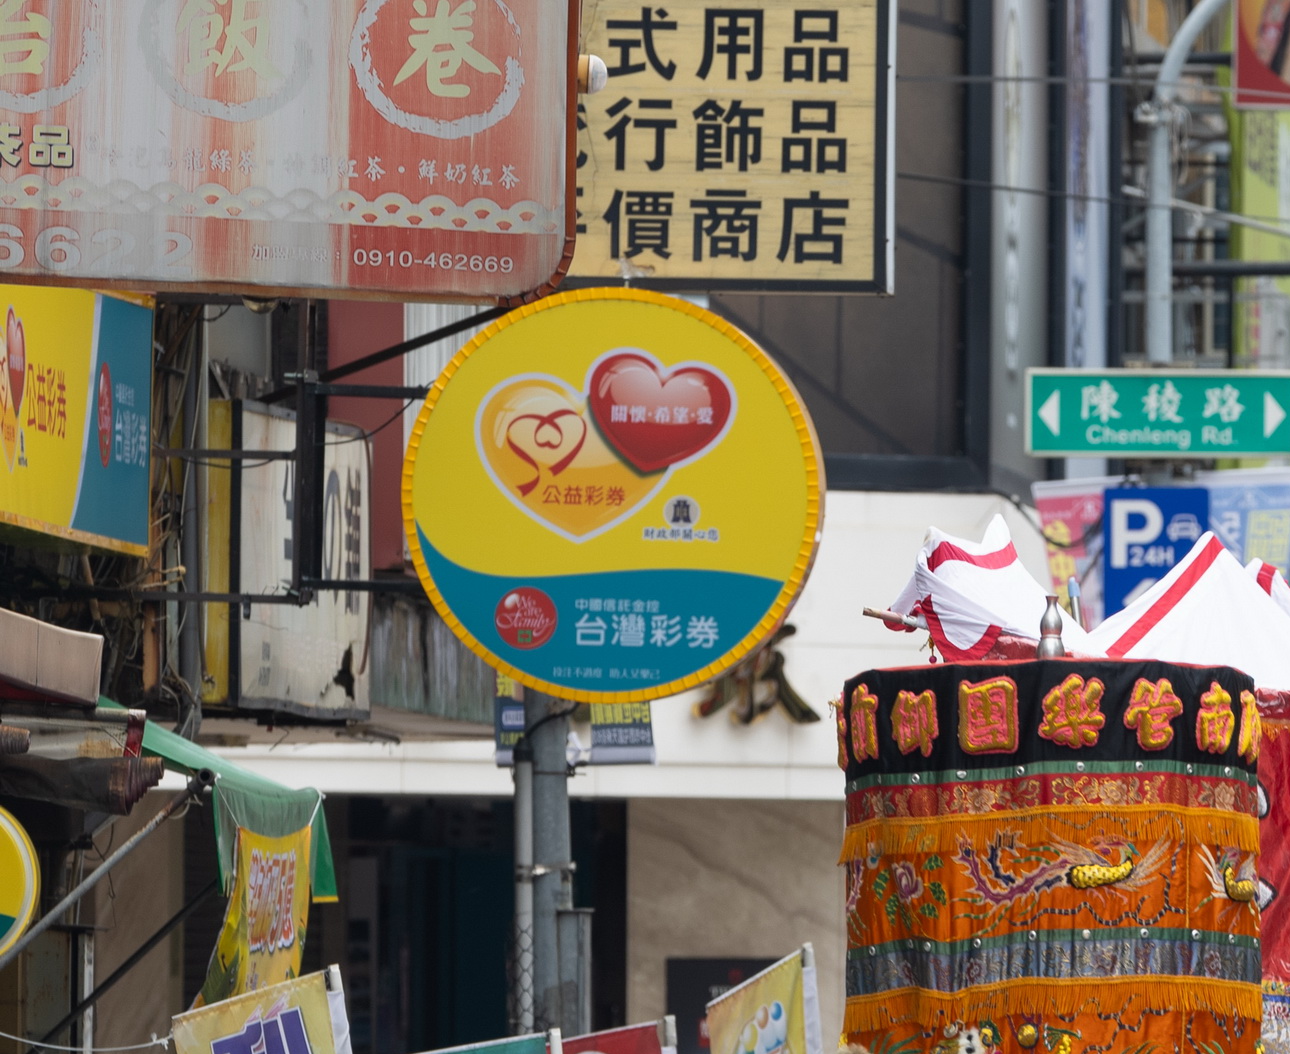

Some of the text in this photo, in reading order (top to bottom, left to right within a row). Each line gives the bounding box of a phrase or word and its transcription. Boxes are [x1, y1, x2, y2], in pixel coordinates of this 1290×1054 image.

[606, 6, 849, 83] 式用品
[576, 97, 847, 173] 行飾品
[576, 189, 849, 264] 價商店
[353, 247, 514, 274] 0910-462669
[26, 362, 67, 440] 公益彩券
[1080, 380, 1246, 423] 陳稜路
[1086, 424, 1191, 450] Chenleng
[542, 485, 626, 507] 公益彩券
[1110, 499, 1164, 568] P
[575, 613, 719, 648] 台灣彩券
